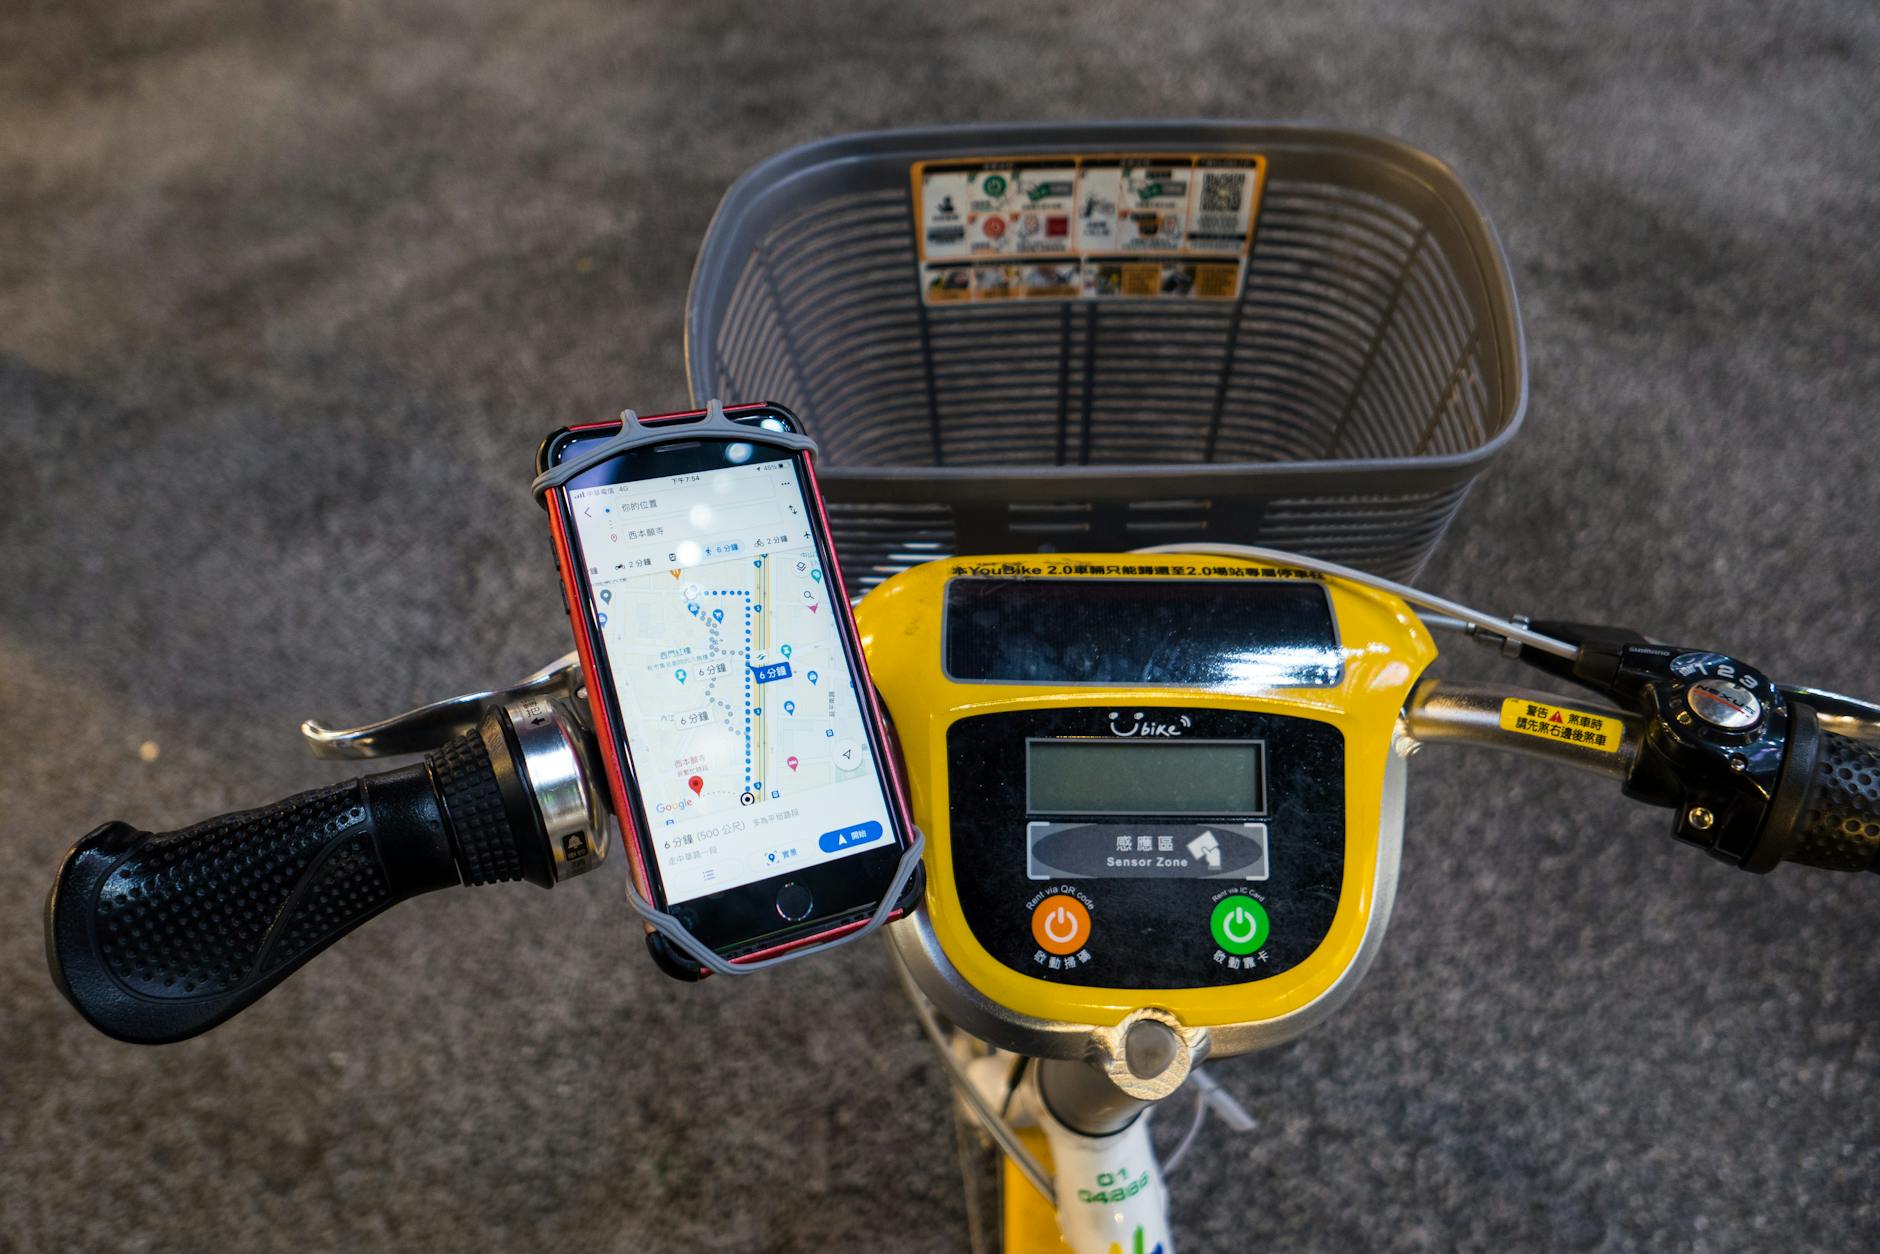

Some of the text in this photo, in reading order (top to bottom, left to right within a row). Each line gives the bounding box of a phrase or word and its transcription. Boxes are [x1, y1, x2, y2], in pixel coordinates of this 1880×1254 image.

[621, 499, 658, 513] 你的位置
[628, 526, 664, 540] 西本願寺
[772, 535, 788, 545] 分鐘
[723, 543, 739, 553] 分鐘
[635, 558, 652, 567] 分鐘
[952, 564, 1042, 576] 本YouBike
[706, 663, 727, 675] 分鐘
[767, 666, 788, 679] 分鐘
[1717, 664, 1735, 679] 2
[1738, 674, 1758, 689] 3
[688, 711, 709, 724] 分鐘
[1526, 704, 1603, 731] 警告 煞車時
[1515, 716, 1608, 746] 請先煞右邊後煞車
[656, 799, 693, 814] Google
[673, 834, 693, 848] 分鐘
[697, 828, 720, 842] (500
[850, 829, 867, 841] 開始
[1116, 835, 1174, 852] 感應區
[1106, 856, 1189, 868] Sensor Zone
[1025, 884, 1095, 910] Rent via QR code
[1211, 889, 1227, 903] Rent
[1228, 887, 1238, 895] via
[1248, 889, 1265, 903] Card
